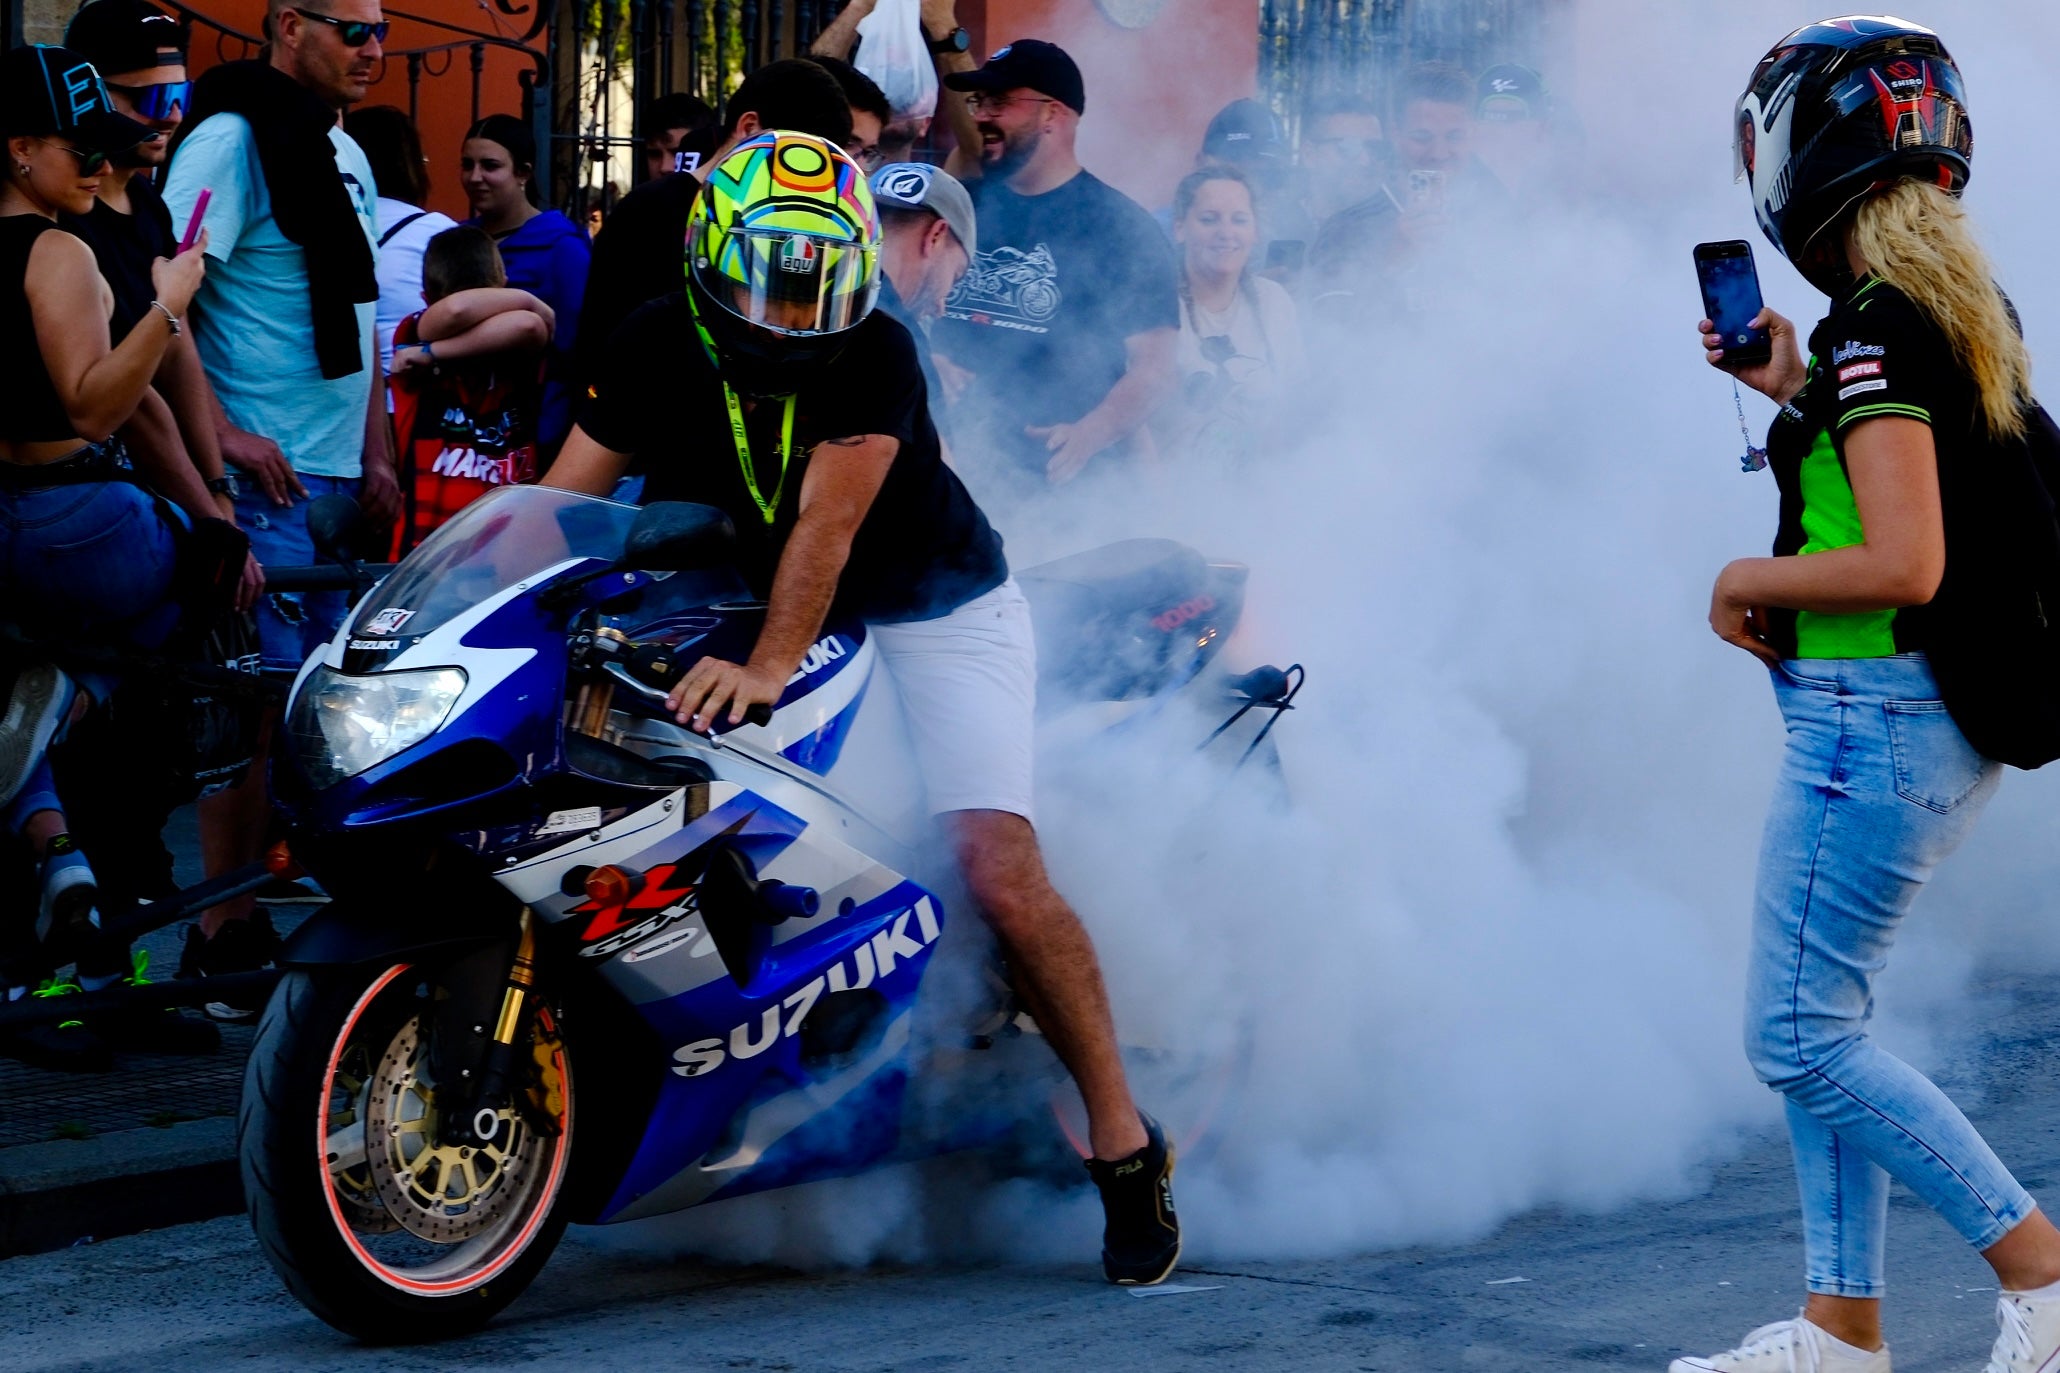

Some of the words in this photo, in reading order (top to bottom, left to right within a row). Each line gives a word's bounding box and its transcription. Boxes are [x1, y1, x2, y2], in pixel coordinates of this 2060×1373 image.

[1891, 78, 1923, 88] SHIRO
[992, 319, 1048, 334] 1000
[1840, 361, 1880, 381] MOTUL
[1150, 593, 1215, 633] 1000
[349, 640, 400, 649] SUZUKI
[785, 635, 847, 687] UKI
[671, 894, 942, 1078] SUZUKI
[1115, 1159, 1144, 1177] FILA
